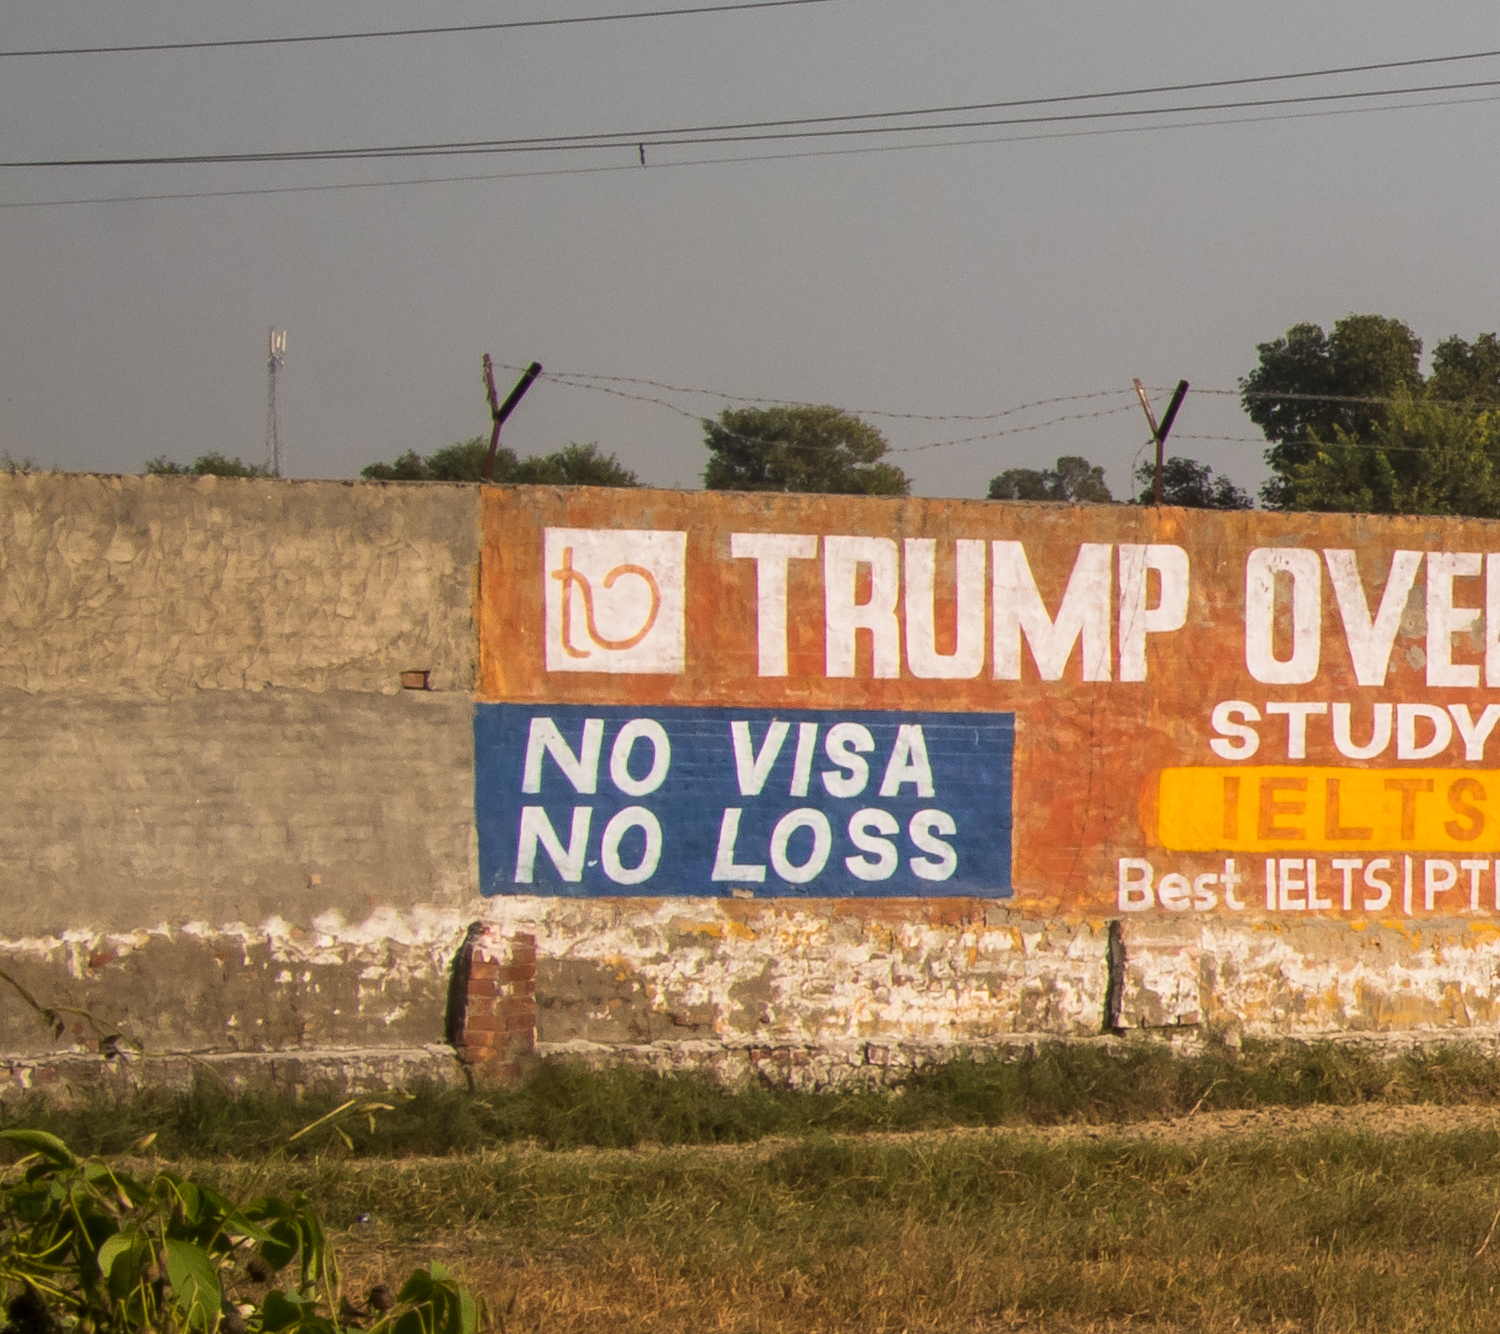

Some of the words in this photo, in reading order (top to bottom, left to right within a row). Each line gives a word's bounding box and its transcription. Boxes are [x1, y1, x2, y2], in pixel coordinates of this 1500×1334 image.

[730, 532, 1190, 683] TRUMP
[522, 717, 672, 797] NO
[731, 720, 936, 798] VISA
[514, 805, 664, 884] NO
[711, 807, 959, 884] LOSS
[1221, 775, 1488, 842] IELTS
[1117, 858, 1244, 913] Best
